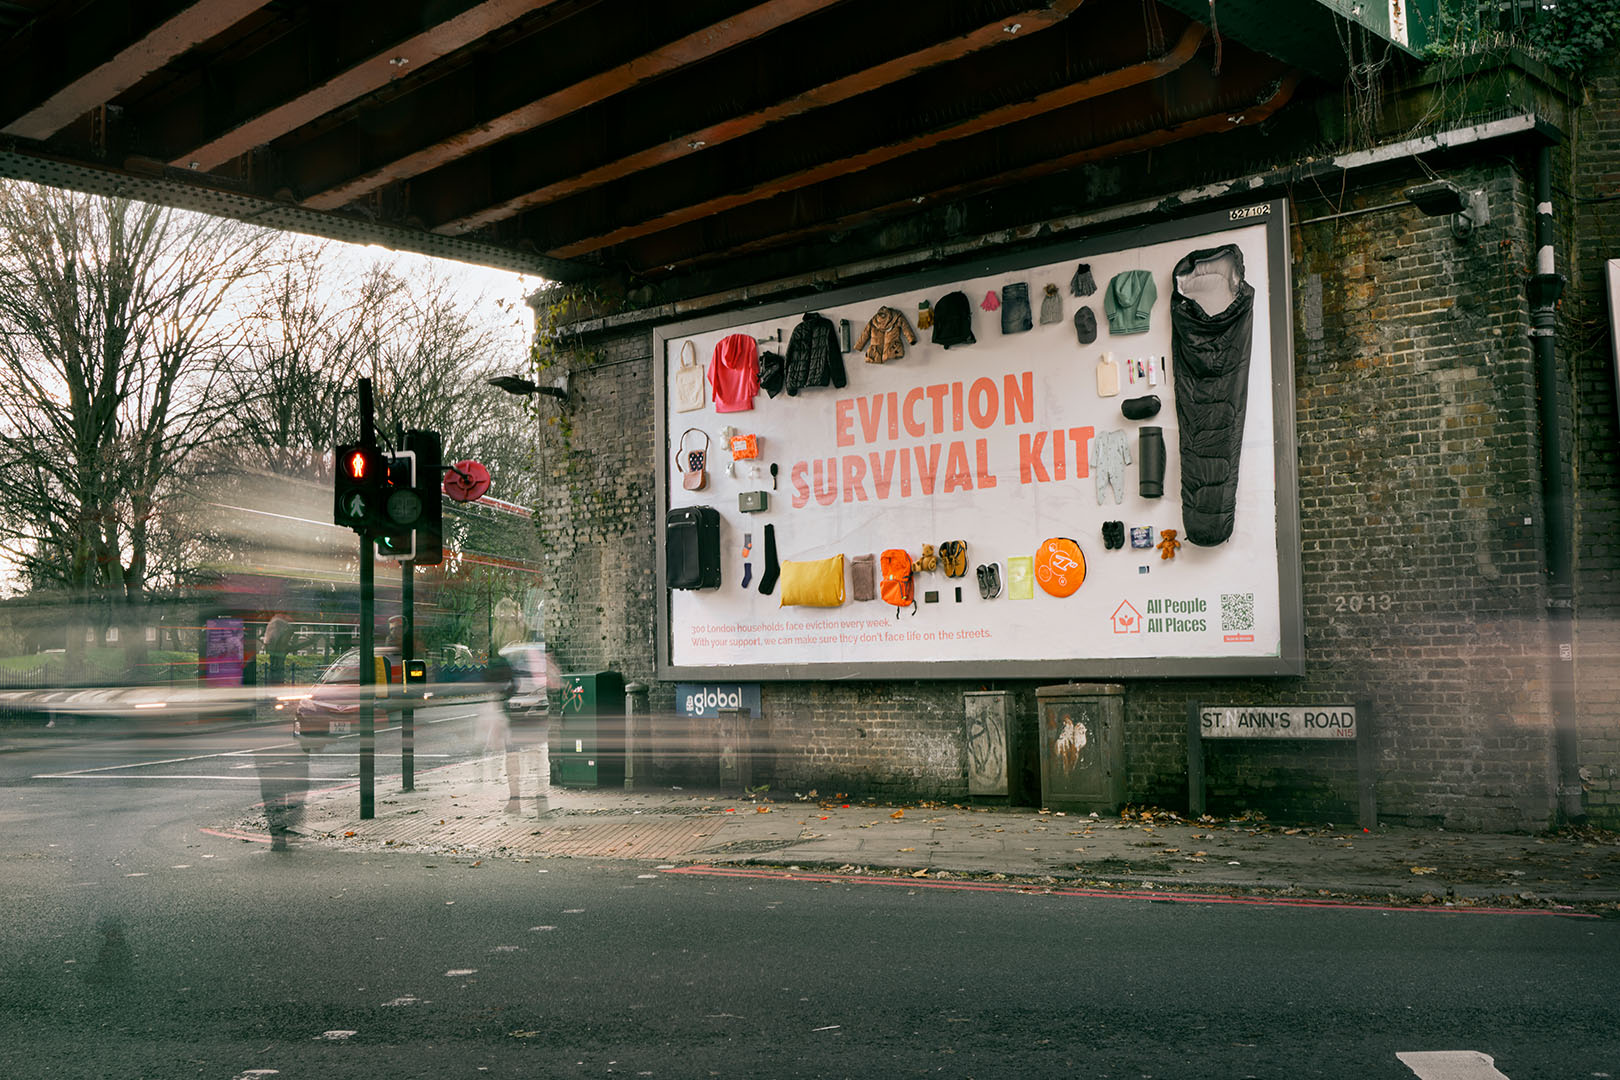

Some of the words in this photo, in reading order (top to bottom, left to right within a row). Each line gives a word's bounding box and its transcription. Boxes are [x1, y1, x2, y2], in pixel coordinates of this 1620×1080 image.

[836, 371, 1034, 448] EVICTION
[791, 438, 997, 509] SURVIVAL
[1019, 426, 1095, 485] KIT
[1147, 599, 1162, 614] All
[1164, 597, 1207, 615] People
[1335, 593, 1392, 613] 2013
[706, 623, 736, 633] London
[737, 621, 784, 633] households
[785, 621, 804, 631] face
[805, 619, 840, 630] eviction
[840, 619, 865, 630] every
[865, 617, 892, 628] week.
[1147, 618, 1163, 633] All
[1165, 617, 1207, 633] Places
[691, 637, 710, 647] With
[711, 638, 728, 648] your
[764, 638, 776, 646] we
[777, 636, 793, 645] can
[794, 635, 818, 645] make
[819, 635, 838, 644] sure
[839, 633, 858, 645] they
[859, 631, 883, 642] don't
[884, 631, 905, 641] face
[906, 630, 922, 641] life
[922, 632, 936, 641] on
[938, 629, 954, 641] the
[955, 627, 992, 640] streets.
[694, 687, 742, 715] global
[1202, 712, 1225, 728] ST.
[1238, 712, 1291, 728] ANN'S
[1304, 712, 1354, 728] ROAD
[1336, 729, 1354, 737] N15
